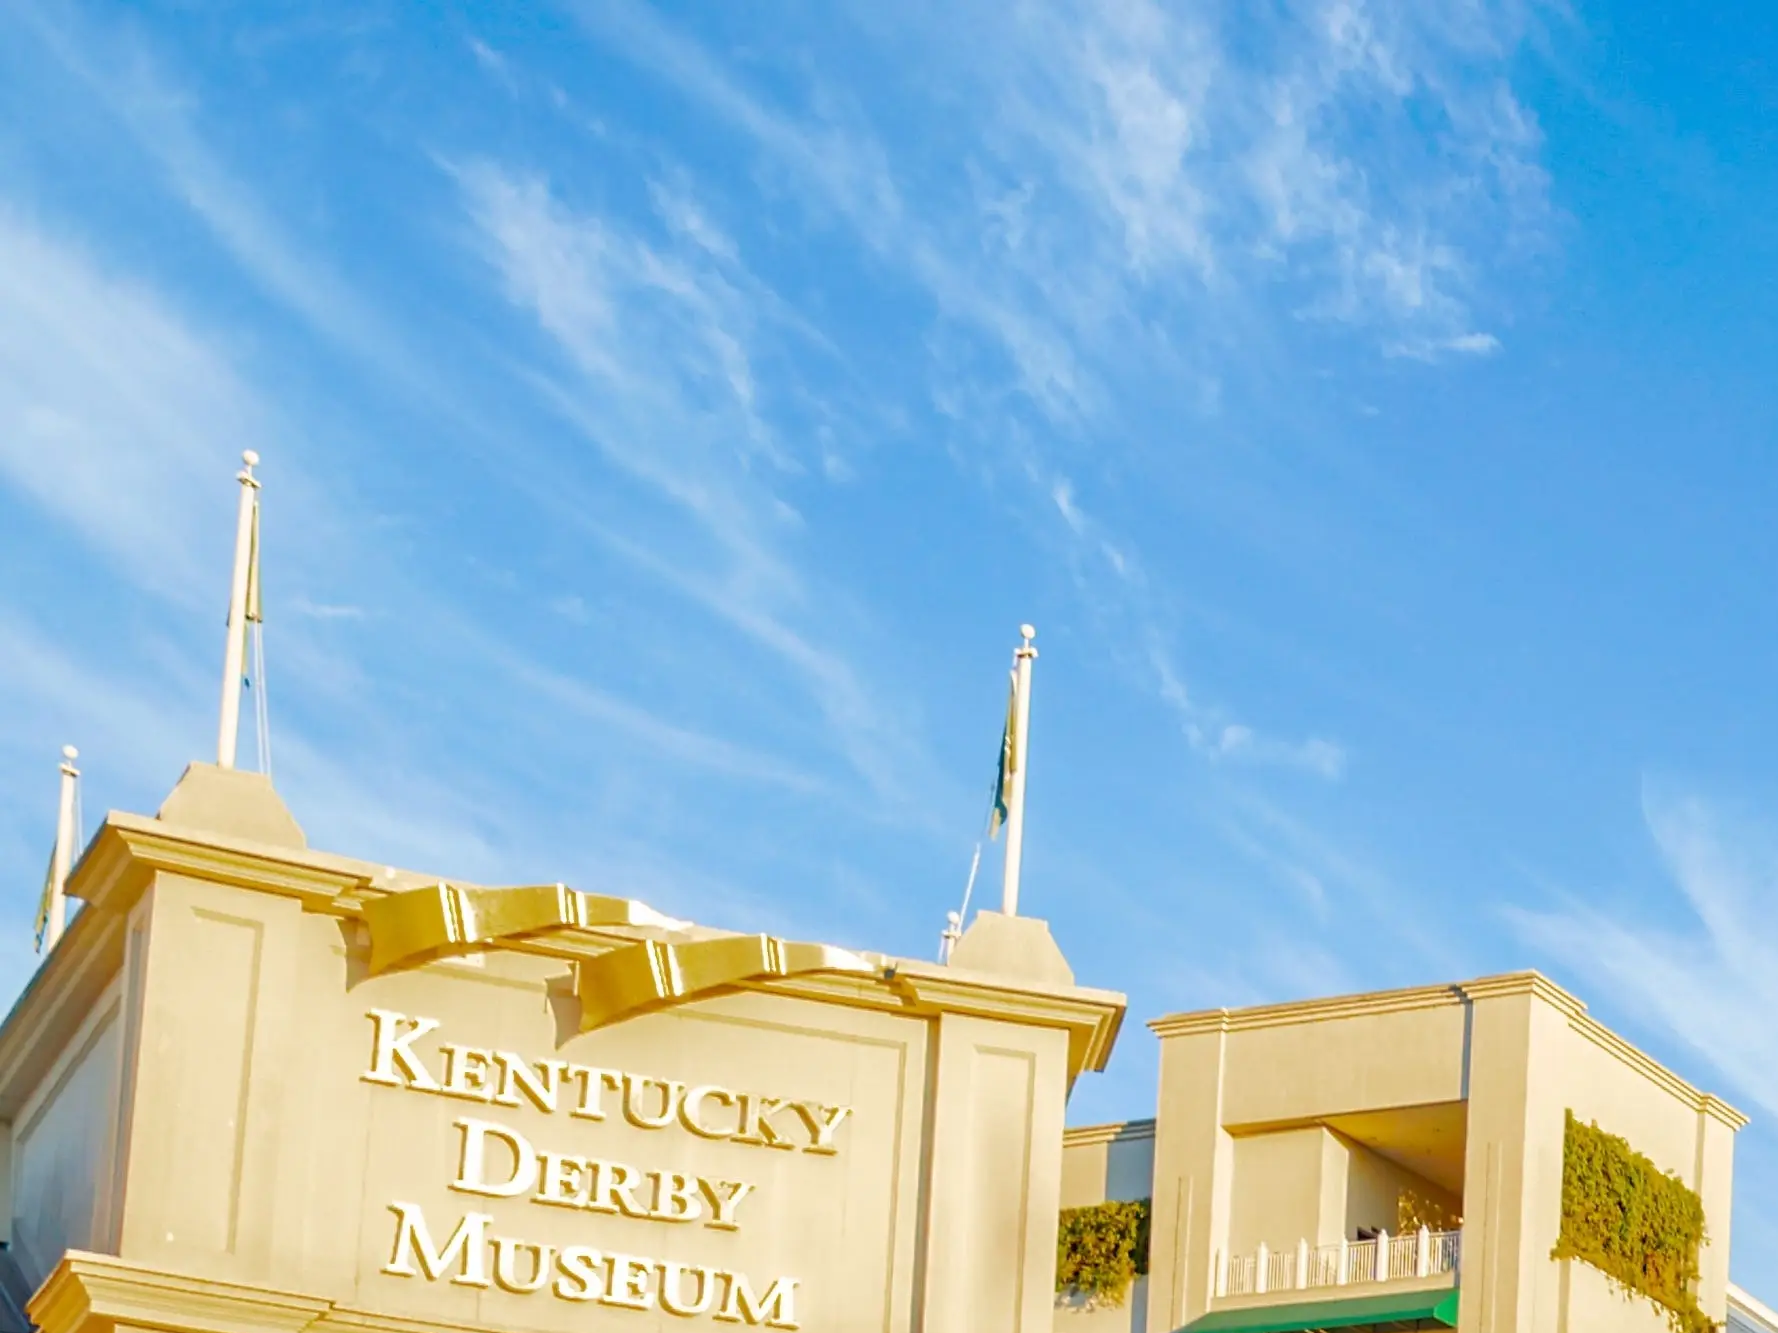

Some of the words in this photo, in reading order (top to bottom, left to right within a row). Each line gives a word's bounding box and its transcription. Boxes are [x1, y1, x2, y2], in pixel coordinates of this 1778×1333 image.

[360, 1007, 851, 1155] KENTUCKY
[449, 1116, 754, 1230] DERBY
[381, 1200, 800, 1330] MUSEUM
